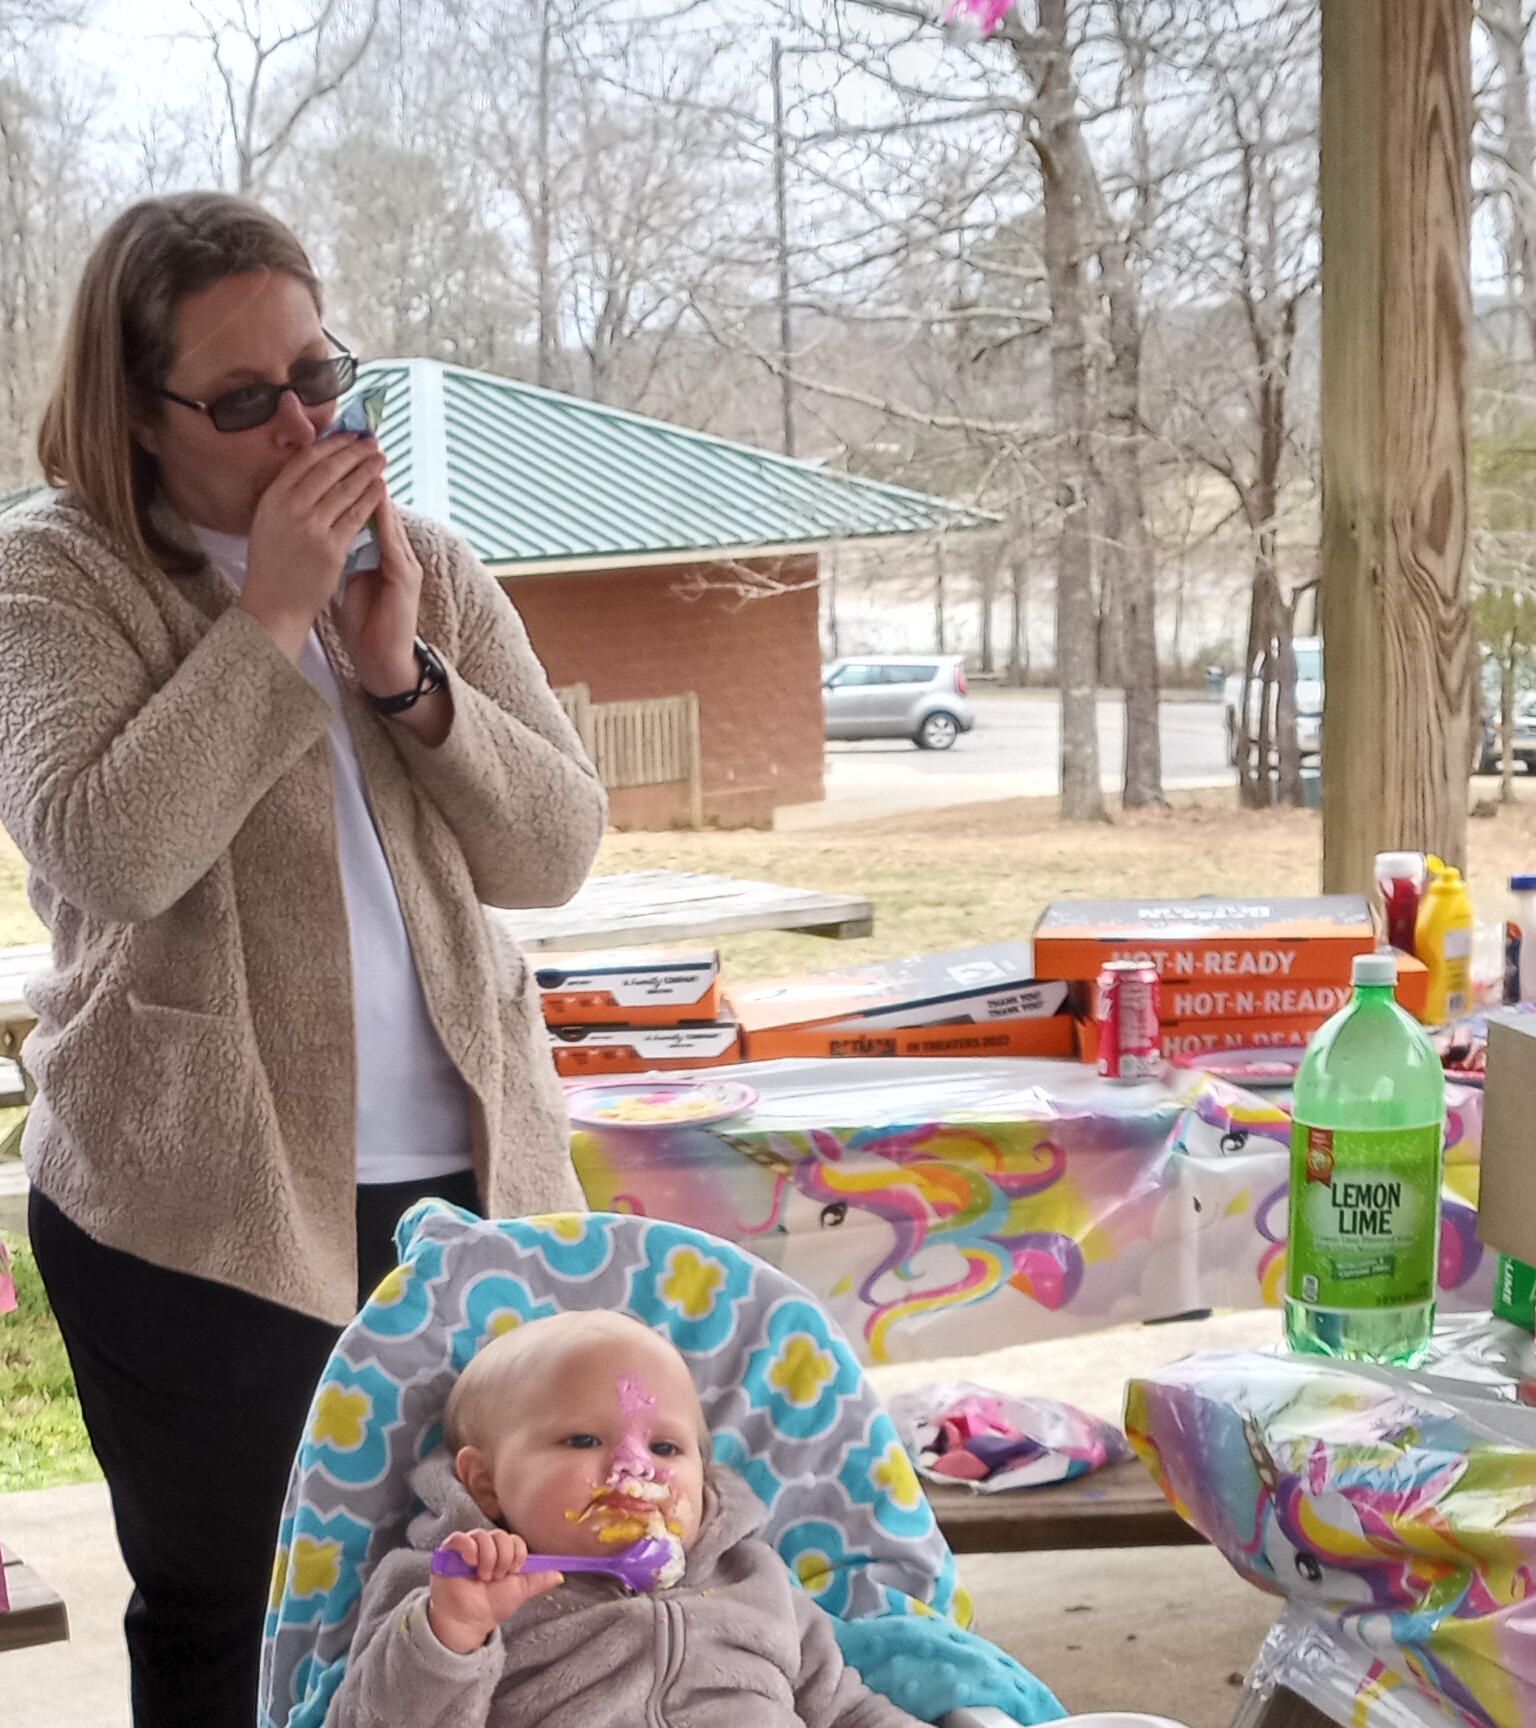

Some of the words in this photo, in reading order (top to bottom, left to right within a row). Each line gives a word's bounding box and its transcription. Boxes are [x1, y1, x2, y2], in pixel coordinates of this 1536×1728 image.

[1174, 987, 1351, 1015] HOT-N-READY
[1331, 1182, 1402, 1209] LEMON
[1339, 1208, 1393, 1235] LIME
